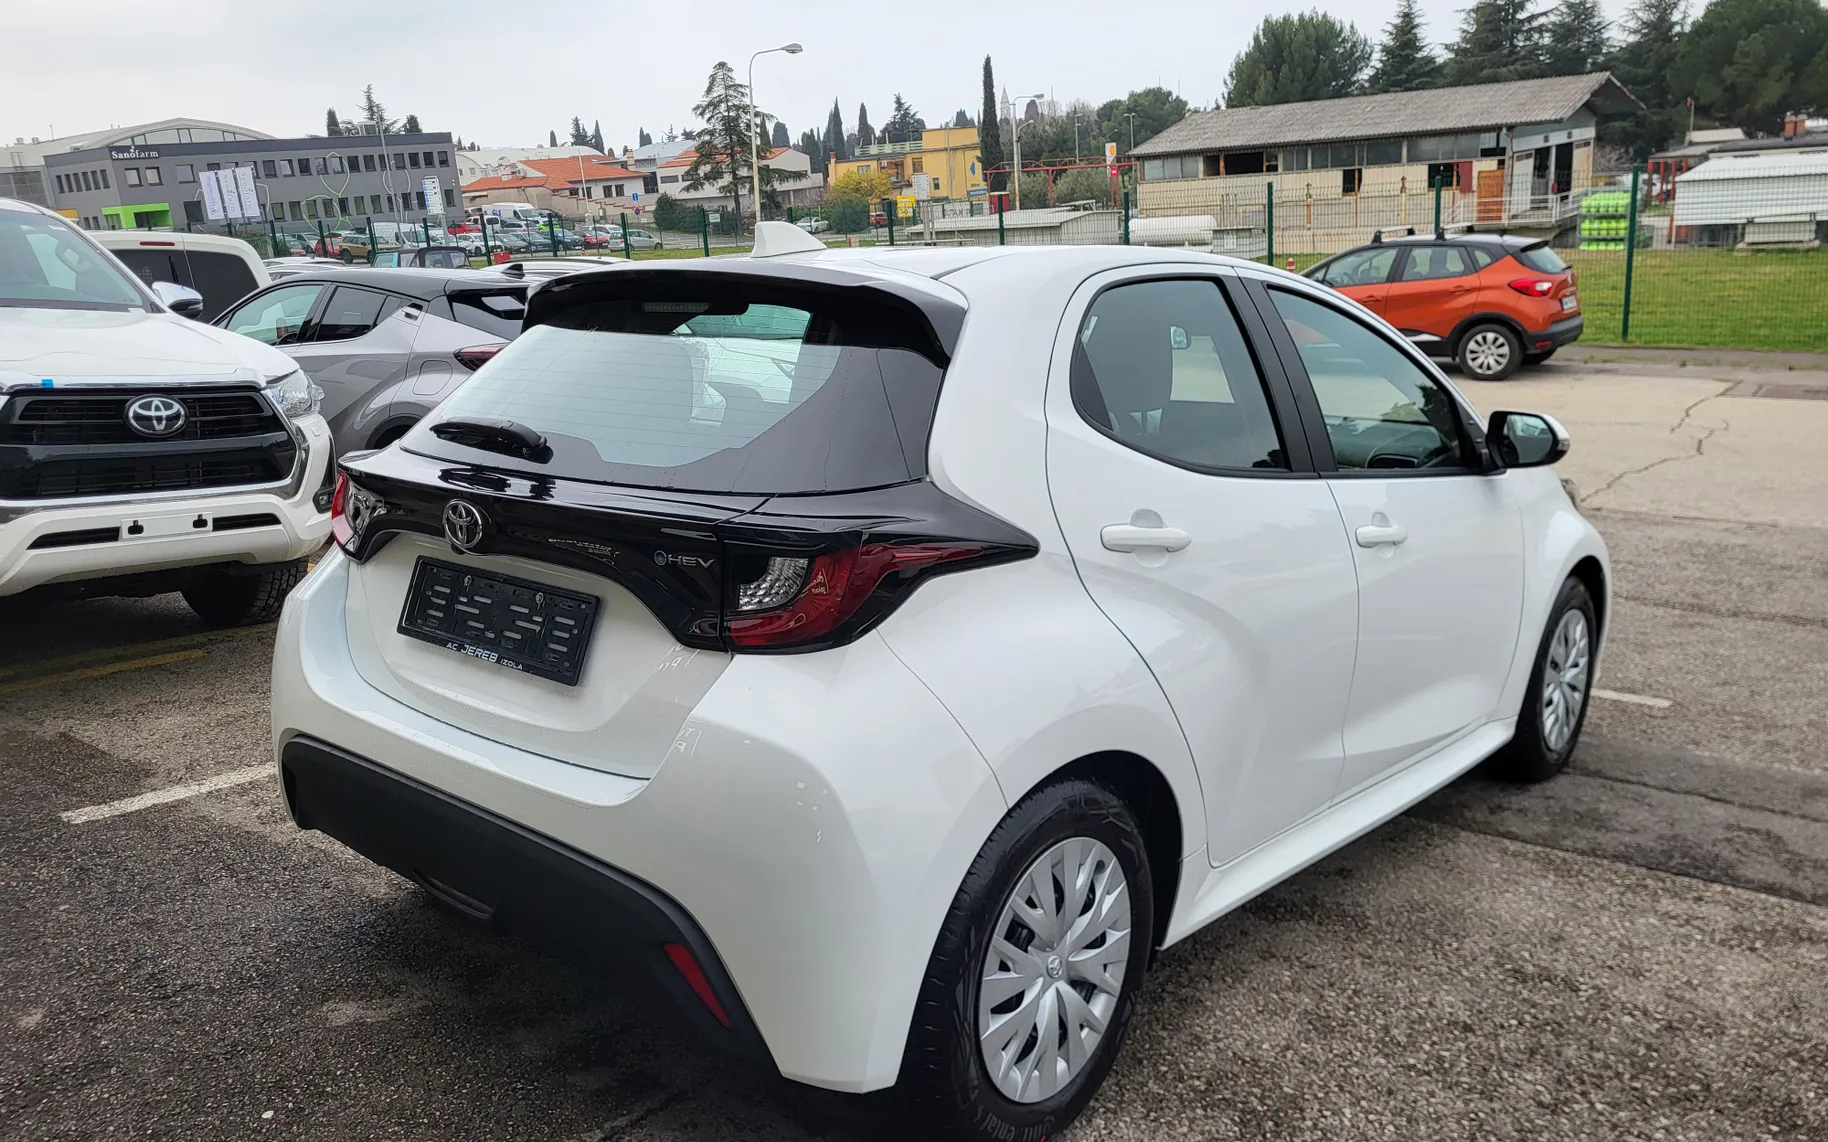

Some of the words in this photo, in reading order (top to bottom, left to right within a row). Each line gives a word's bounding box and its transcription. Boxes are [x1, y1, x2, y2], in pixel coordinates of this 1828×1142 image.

[111, 148, 159, 159] Sanofarm
[668, 554, 715, 569] HEV
[446, 642, 459, 651] AC
[461, 644, 498, 662] JEREB
[500, 659, 523, 670] IZOLA
